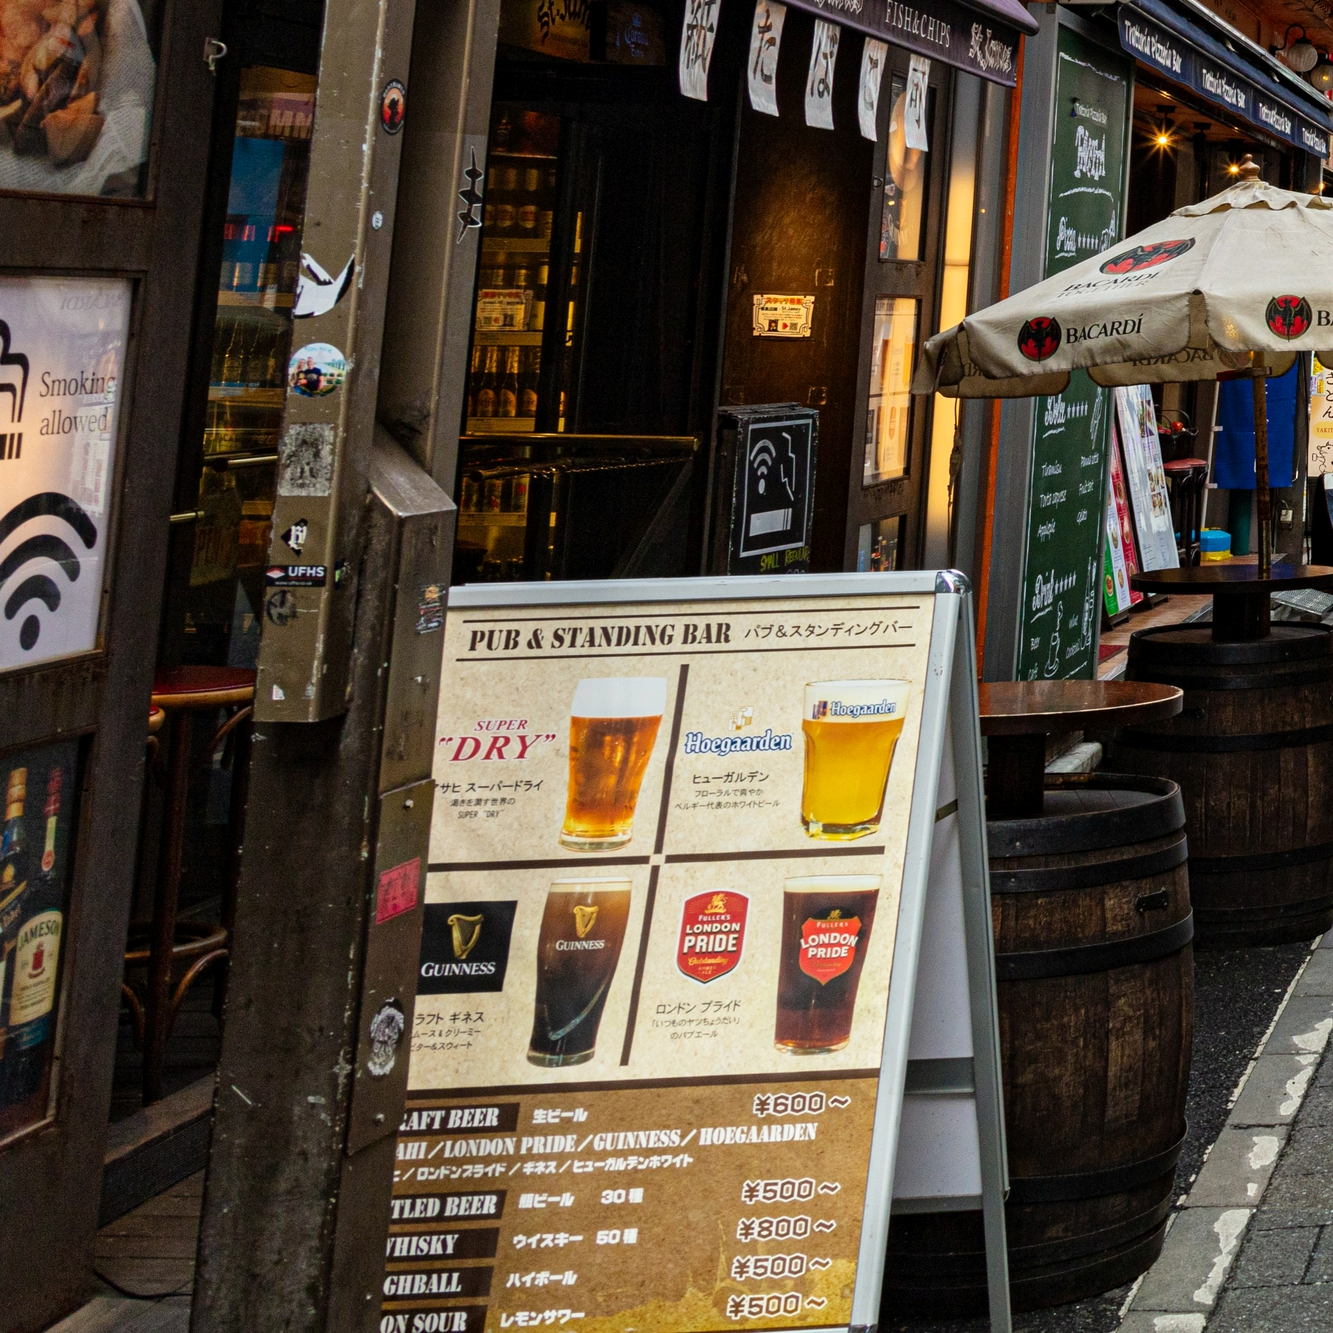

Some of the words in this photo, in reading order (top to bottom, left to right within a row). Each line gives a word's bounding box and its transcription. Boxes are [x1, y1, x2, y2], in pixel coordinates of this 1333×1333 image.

[38, 369, 117, 402] Smoking
[38, 407, 108, 438] allowed
[288, 566, 325, 578] UFHS
[468, 628, 519, 652] PUB
[526, 630, 545, 650] &
[550, 623, 676, 649] STANDING
[681, 623, 732, 645] BAR
[829, 700, 897, 718] Hoegaarden
[473, 719, 528, 732] SUPER
[683, 730, 794, 757] Hoegaarden
[692, 771, 770, 785] ヒューガルデン
[685, 922, 741, 934] LONDON
[555, 939, 605, 951] GUINNESS
[682, 935, 738, 954] PRIDE
[800, 934, 858, 949] LONDON
[807, 945, 849, 959] PRIDE
[420, 961, 496, 978] GUINNESS
[655, 1002, 697, 1015] ロンドン
[700, 1000, 742, 1013] プライド
[532, 1108, 588, 1125] 生ビール
[444, 1195, 497, 1217] BEER
[506, 1271, 577, 1287] ハイボール
[411, 1312, 467, 1333] SOUR
[500, 1309, 585, 1328] レモンサワー
